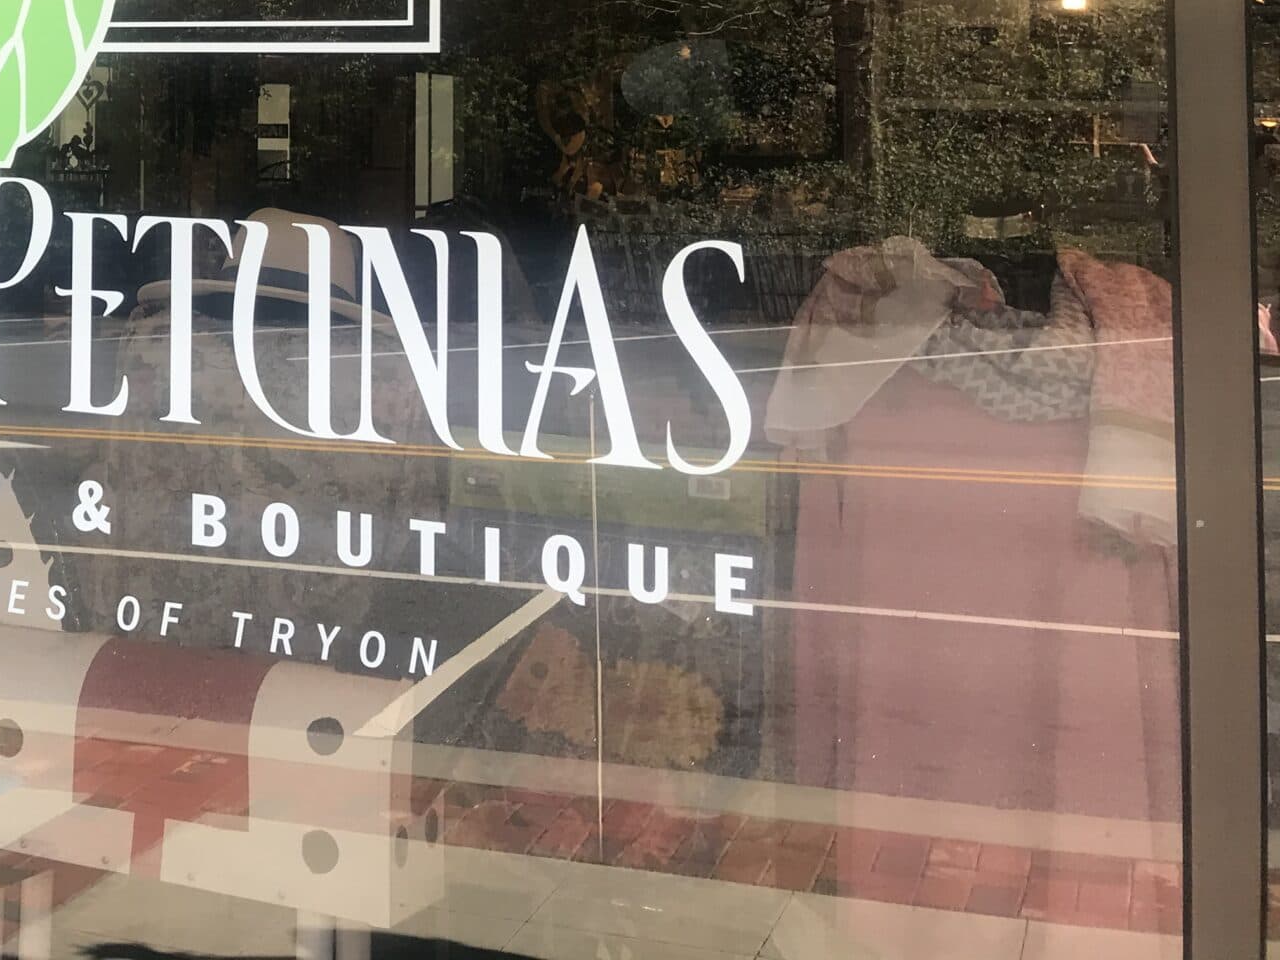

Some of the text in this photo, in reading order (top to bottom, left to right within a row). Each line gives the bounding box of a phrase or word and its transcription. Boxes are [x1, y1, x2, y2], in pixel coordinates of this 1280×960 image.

[72, 480, 111, 534] &
[191, 493, 753, 616] BOUTIQUE
[117, 596, 183, 637] OF
[231, 613, 437, 676] TRYON
